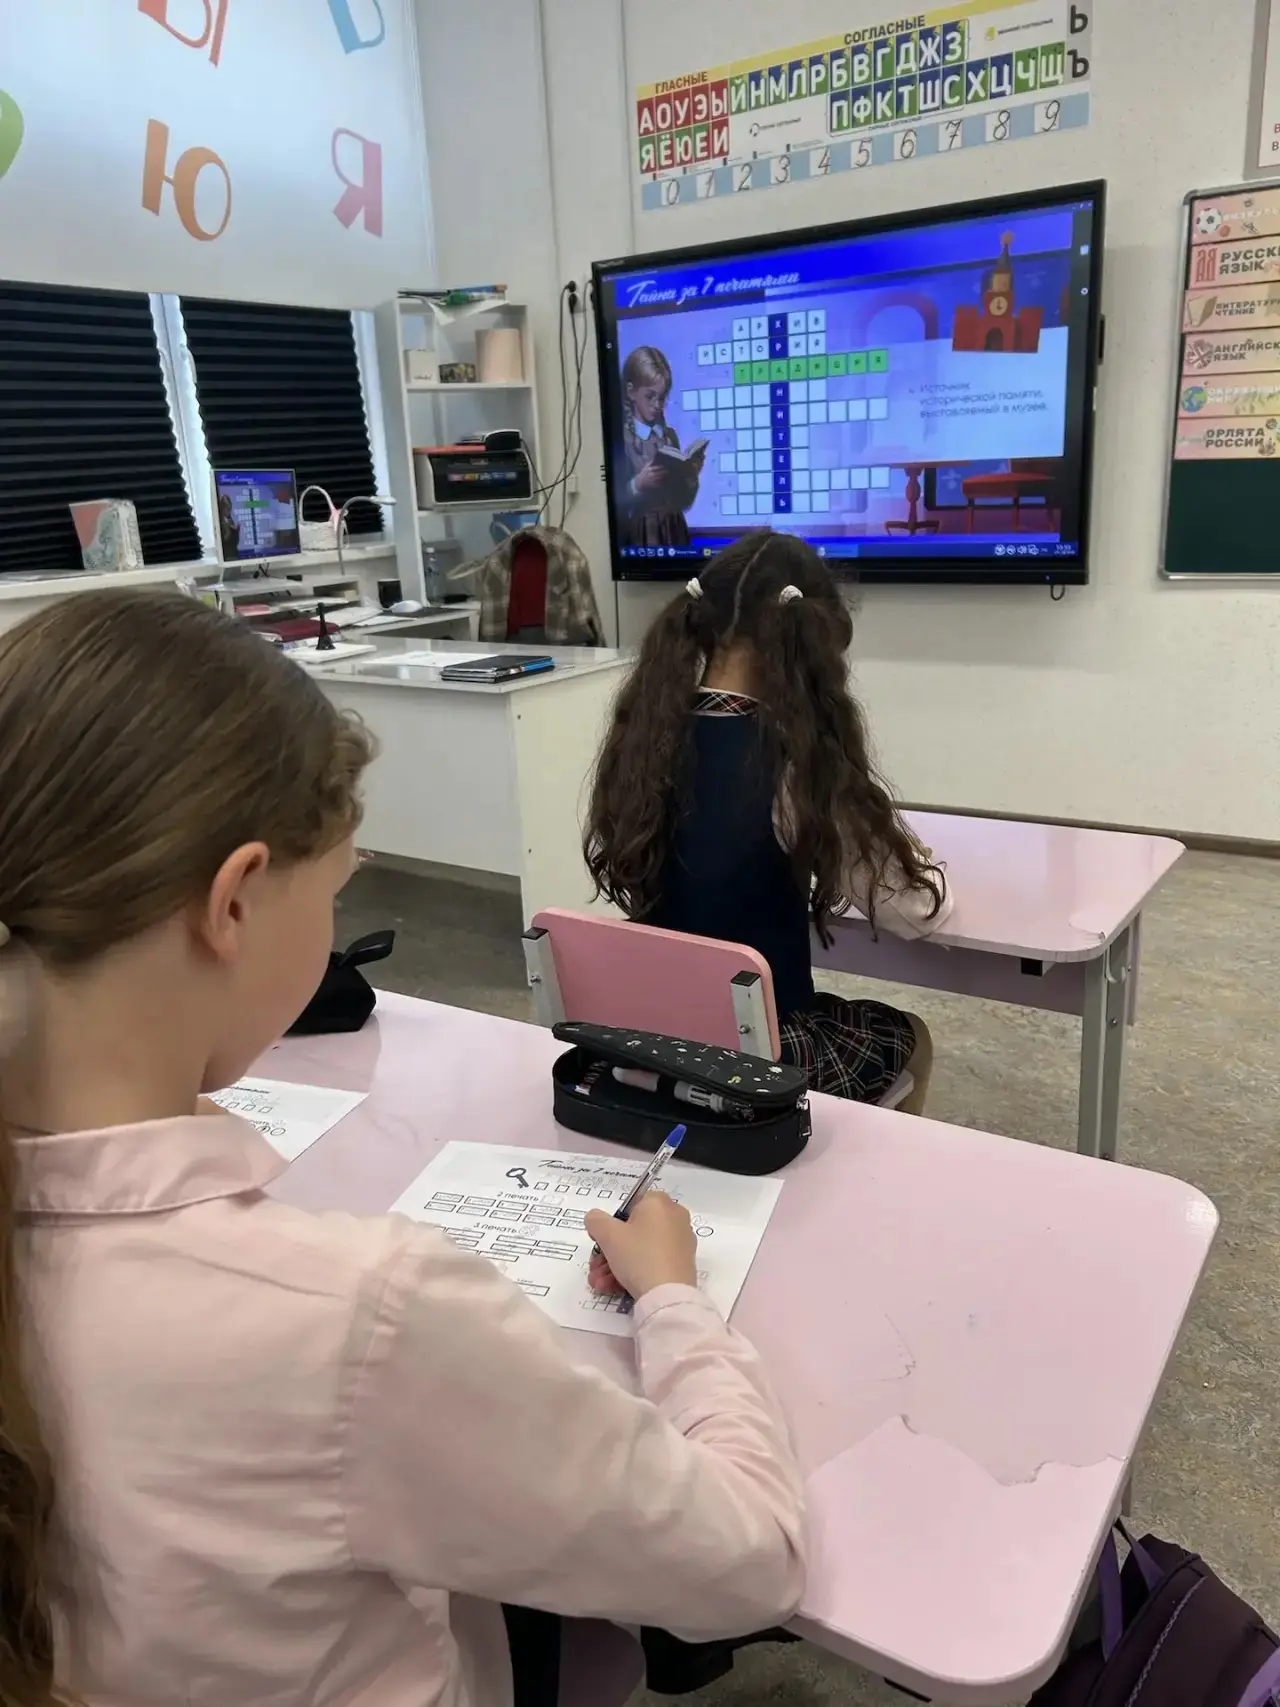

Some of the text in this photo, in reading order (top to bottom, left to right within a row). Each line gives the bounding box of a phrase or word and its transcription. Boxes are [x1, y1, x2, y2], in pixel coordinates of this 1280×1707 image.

[844, 15, 926, 45] СОГЛАСНЫЕ
[655, 71, 708, 94] ГЛАСНЫЕ
[737, 163, 753, 191] 2
[775, 154, 791, 183] 3
[818, 147, 831, 176] 4
[855, 138, 873, 167] 5
[900, 129, 917, 159] 6
[946, 119, 964, 150] 7
[992, 110, 1011, 141] 8
[1042, 100, 1061, 132] 9
[142, 118, 231, 241] Ю
[332, 127, 383, 238] Я
[1219, 259, 1265, 275] ЯЗЫК
[626, 271, 800, 308] Тайна за 7 печатями
[1215, 307, 1255, 316] ЧТЕНИЕ
[1205, 437, 1264, 448] РОССИИ
[1206, 428, 1265, 438] ОРЛЯТА
[504, 1192, 539, 1202] печать
[481, 1223, 517, 1234] печать
